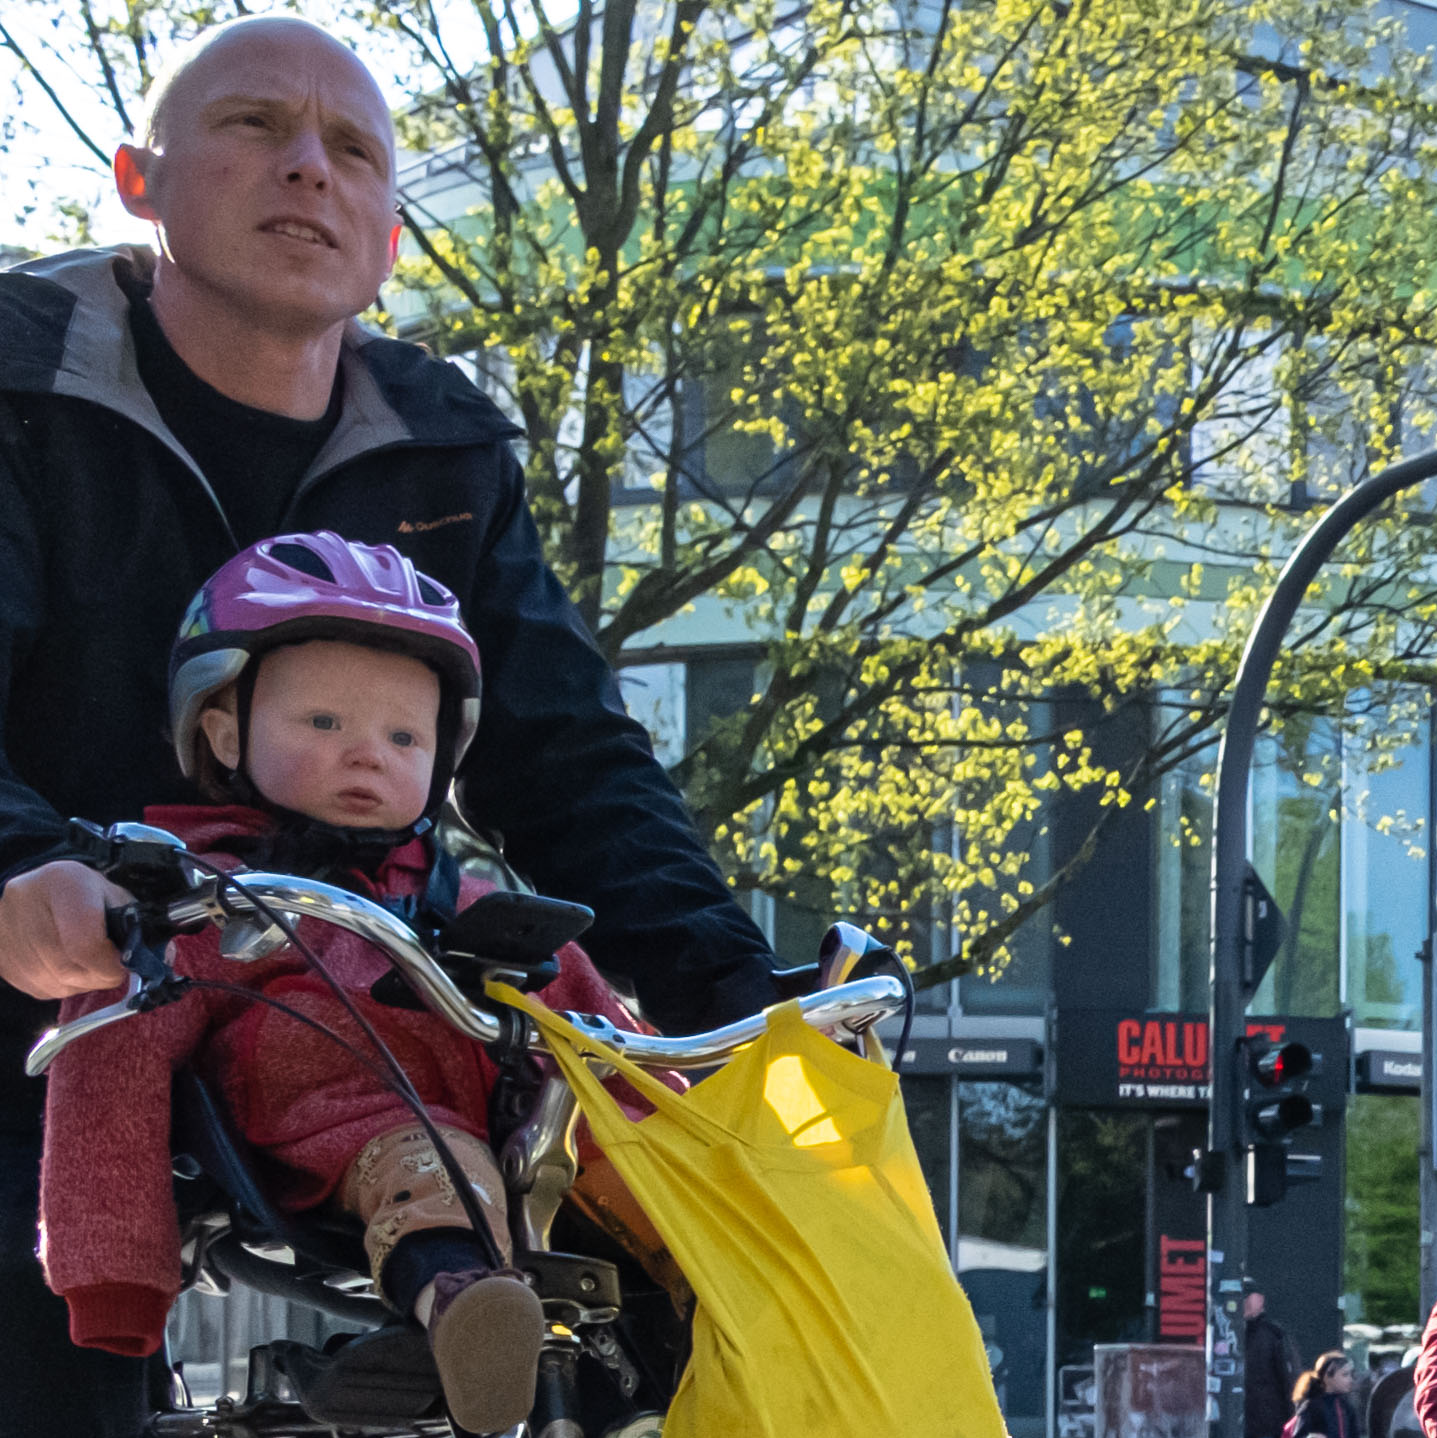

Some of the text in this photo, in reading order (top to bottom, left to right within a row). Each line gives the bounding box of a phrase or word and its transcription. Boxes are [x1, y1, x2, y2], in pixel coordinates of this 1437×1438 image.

[1118, 1019, 1286, 1067] CALU
[948, 1047, 1008, 1063] Canon
[1383, 1061, 1424, 1077] Koda
[1119, 1084, 1145, 1098] IT'S
[1147, 1085, 1197, 1099] WHERE
